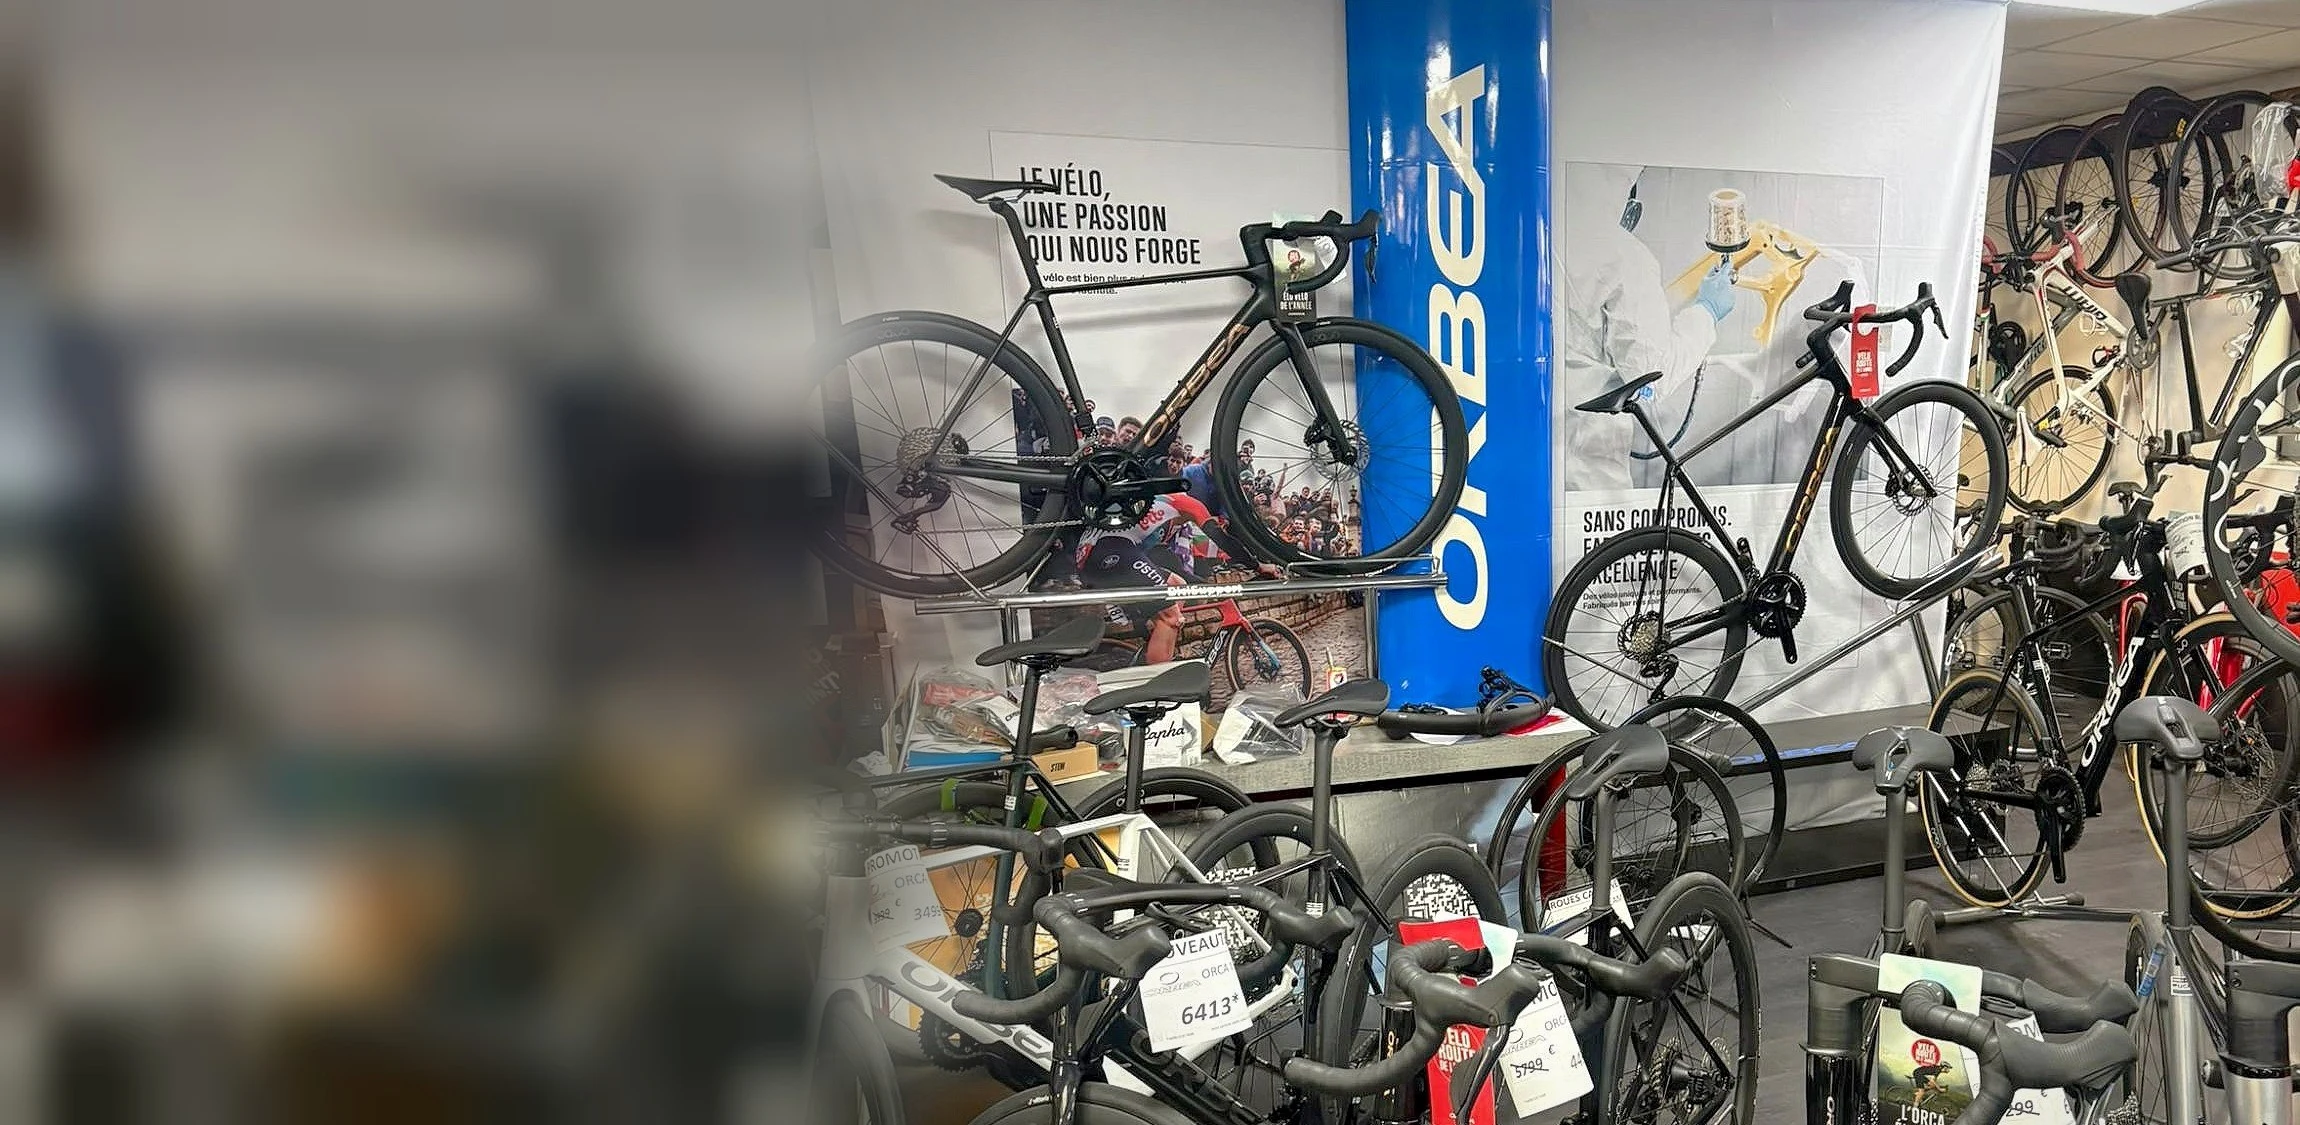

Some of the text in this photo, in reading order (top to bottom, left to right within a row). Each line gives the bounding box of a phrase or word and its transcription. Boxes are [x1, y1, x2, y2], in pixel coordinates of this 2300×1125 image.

[1050, 162, 1111, 201] VÉLO,
[1024, 202, 1167, 232] UNE PASSION
[1027, 235, 1201, 265] QUI NOUS FORGE
[1066, 273, 1081, 282] est
[1084, 273, 1104, 283] bien
[1144, 323, 1250, 447] ORBEA
[1583, 510, 1625, 533] SANS
[1593, 559, 1678, 585] CELLENCE
[2081, 637, 2145, 767] ORBEA
[1550, 893, 1580, 909] ROUES
[1445, 1027, 1471, 1048] ELO
[1901, 1103, 1945, 1125] L'ORCA
